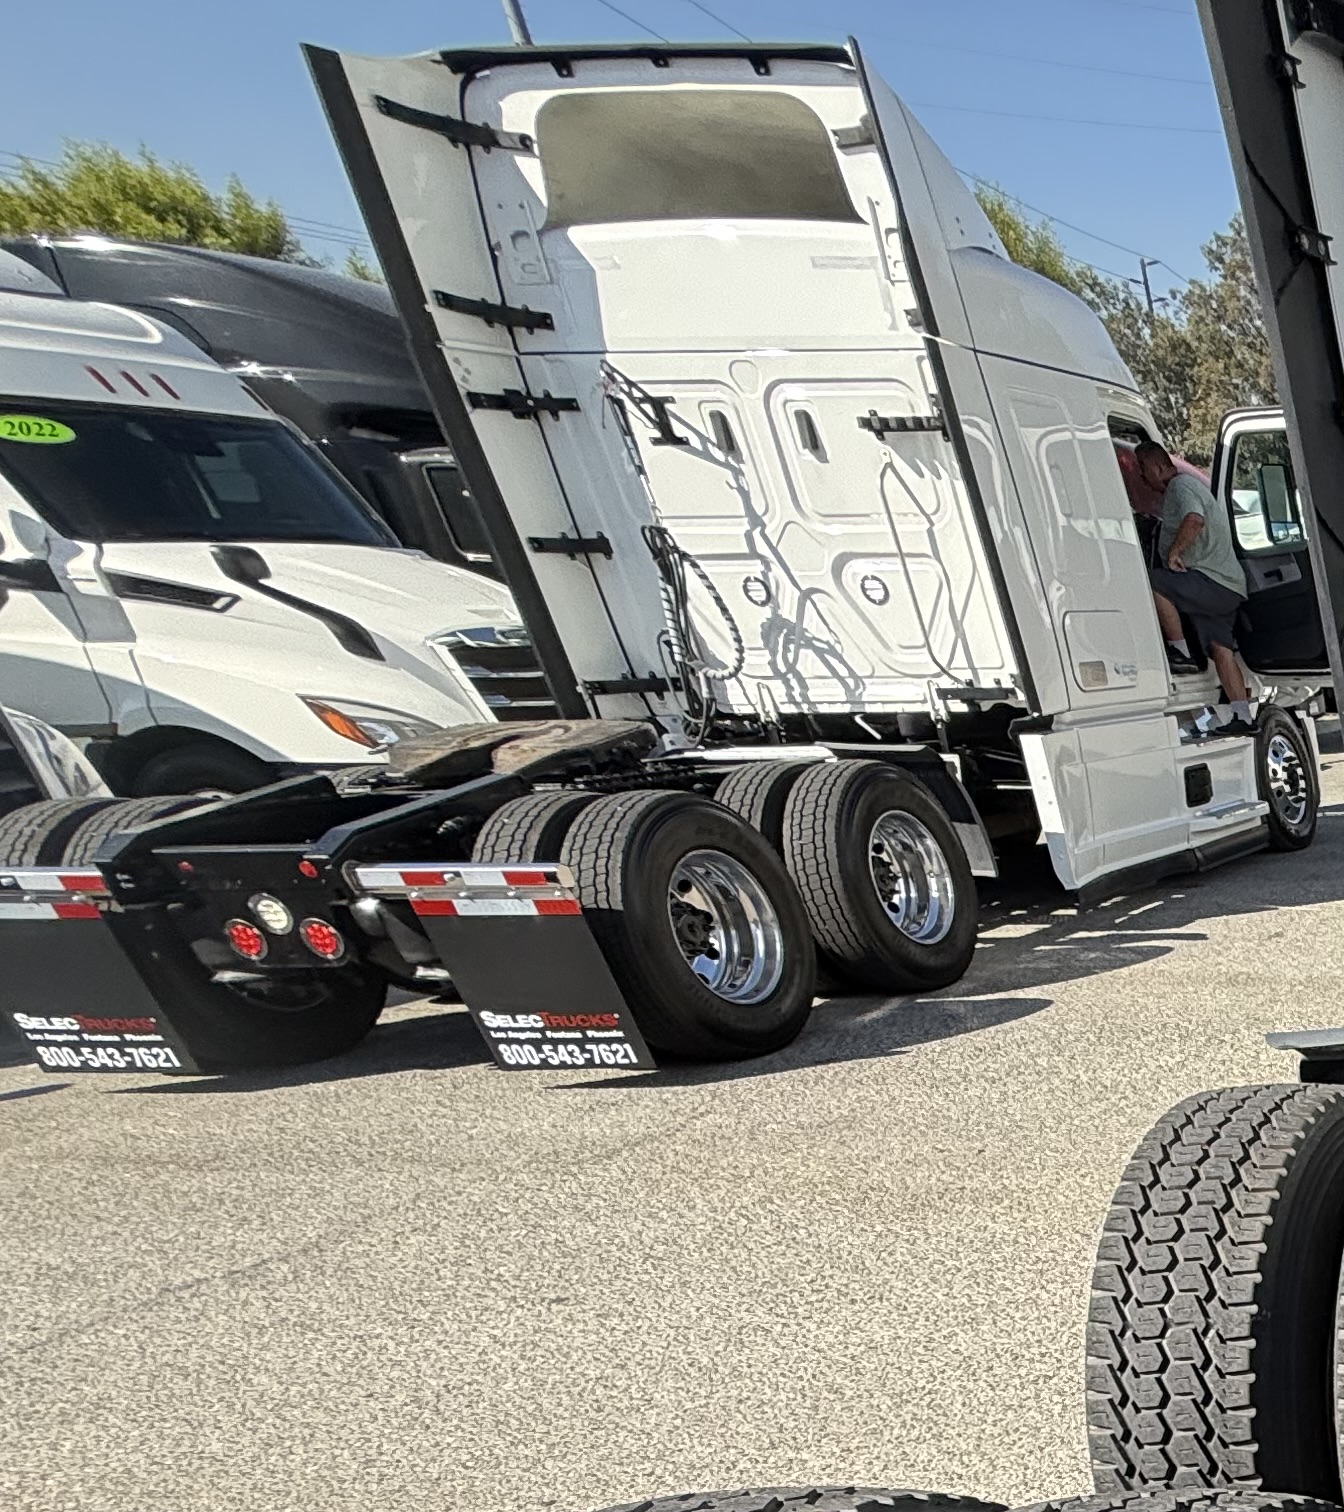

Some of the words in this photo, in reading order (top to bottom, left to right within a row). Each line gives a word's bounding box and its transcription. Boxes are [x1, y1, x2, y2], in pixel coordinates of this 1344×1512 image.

[4, 421, 59, 437] 2022
[36, 1045, 182, 1068] 800-543-7621
[498, 1043, 638, 1066] 800-543-7621
